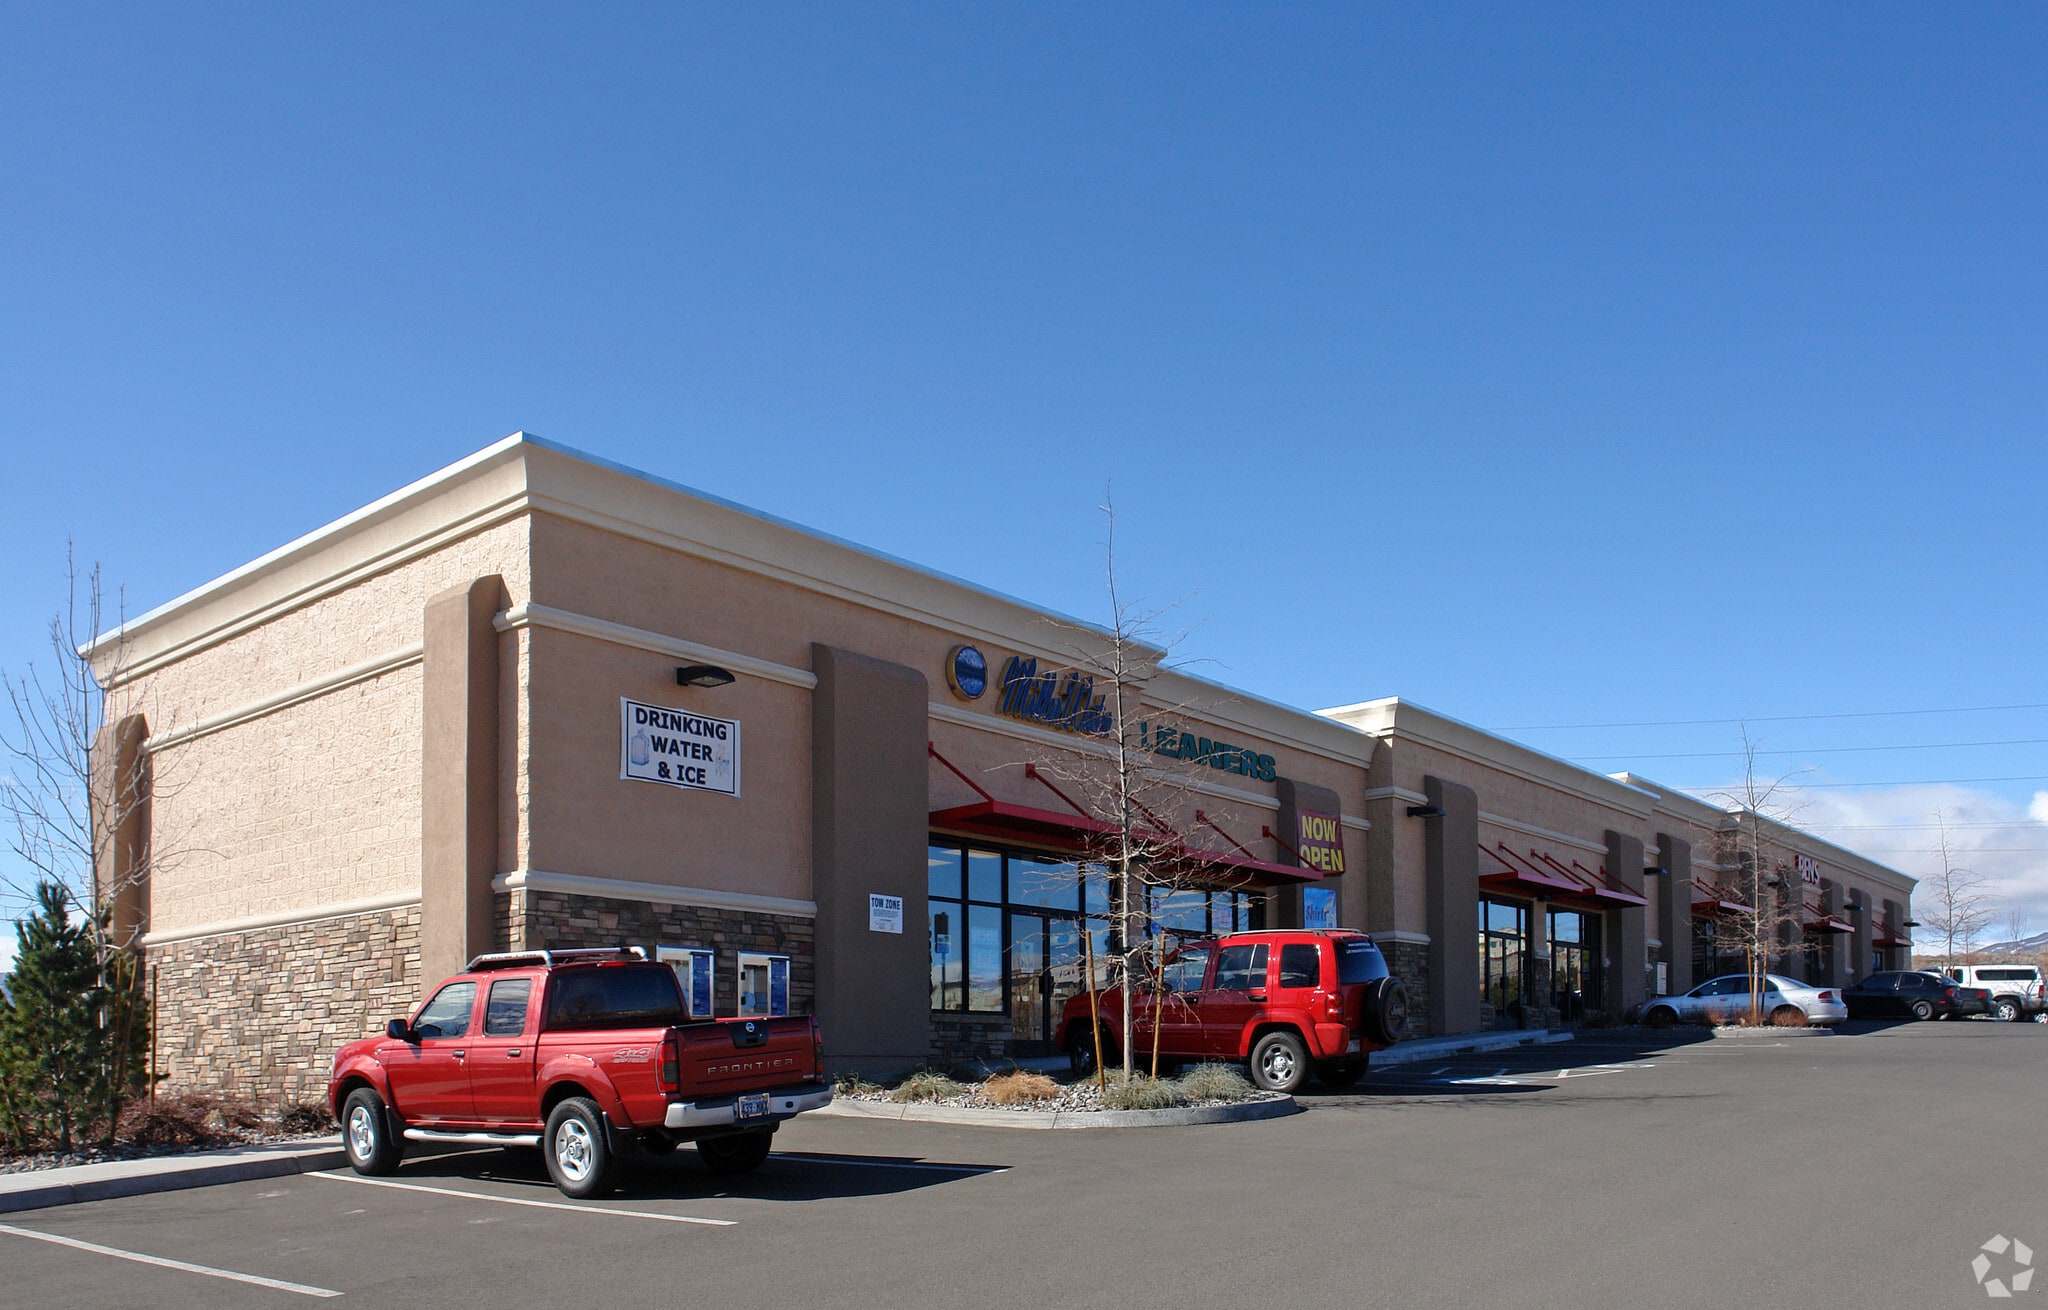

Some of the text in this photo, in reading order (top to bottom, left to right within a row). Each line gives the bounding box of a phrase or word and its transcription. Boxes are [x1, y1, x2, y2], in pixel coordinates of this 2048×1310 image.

[635, 707, 727, 740] DRINKING
[651, 735, 713, 762] WATER
[657, 761, 706, 785] & ICE
[1301, 814, 1337, 843] NOW
[1300, 844, 1344, 872] OPEN
[871, 897, 900, 910] TOW ZONE
[708, 1058, 793, 1075] FRONTIER
